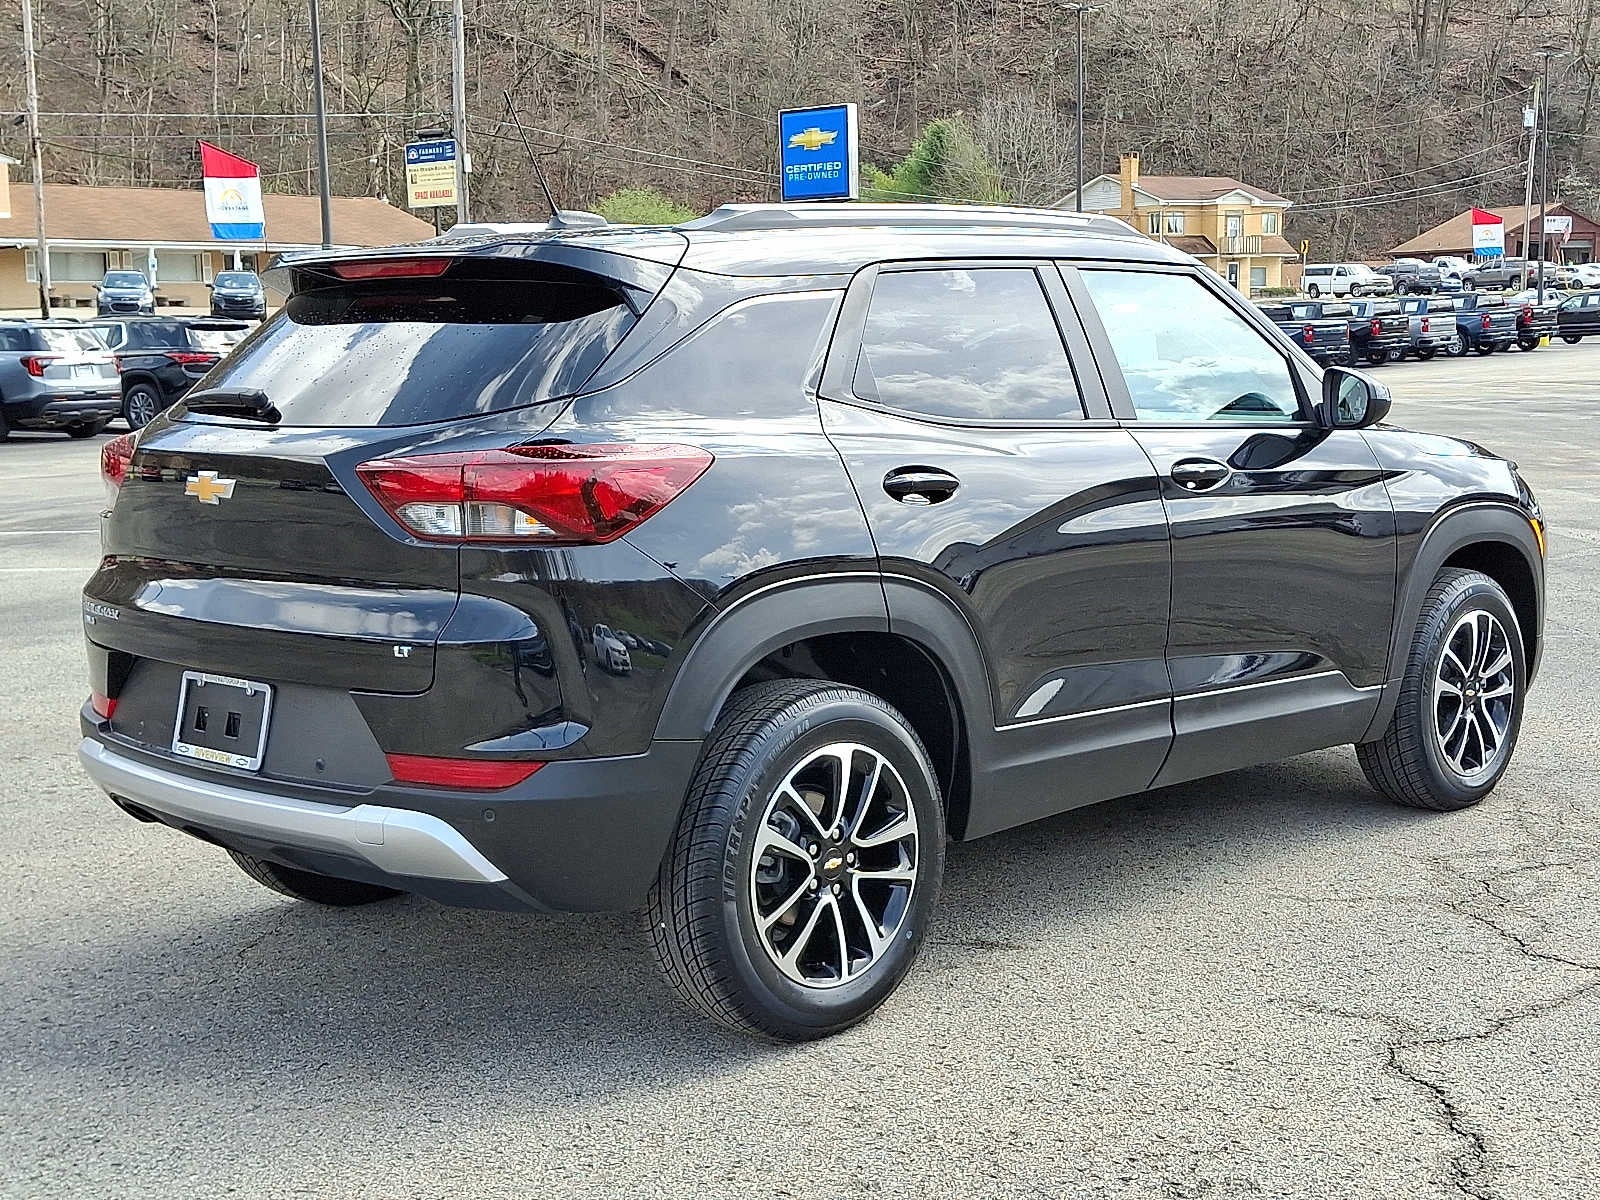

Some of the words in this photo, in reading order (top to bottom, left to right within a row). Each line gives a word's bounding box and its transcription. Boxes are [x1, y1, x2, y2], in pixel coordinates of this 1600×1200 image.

[785, 161, 842, 174] CERTIFIED
[788, 170, 840, 181] PRE-OWNED
[414, 189, 429, 199] SPACE
[429, 187, 453, 199] AVAILABLE
[393, 645, 412, 658] LT
[193, 746, 233, 764] RIVERVIEW
[722, 823, 743, 902] TIGER
